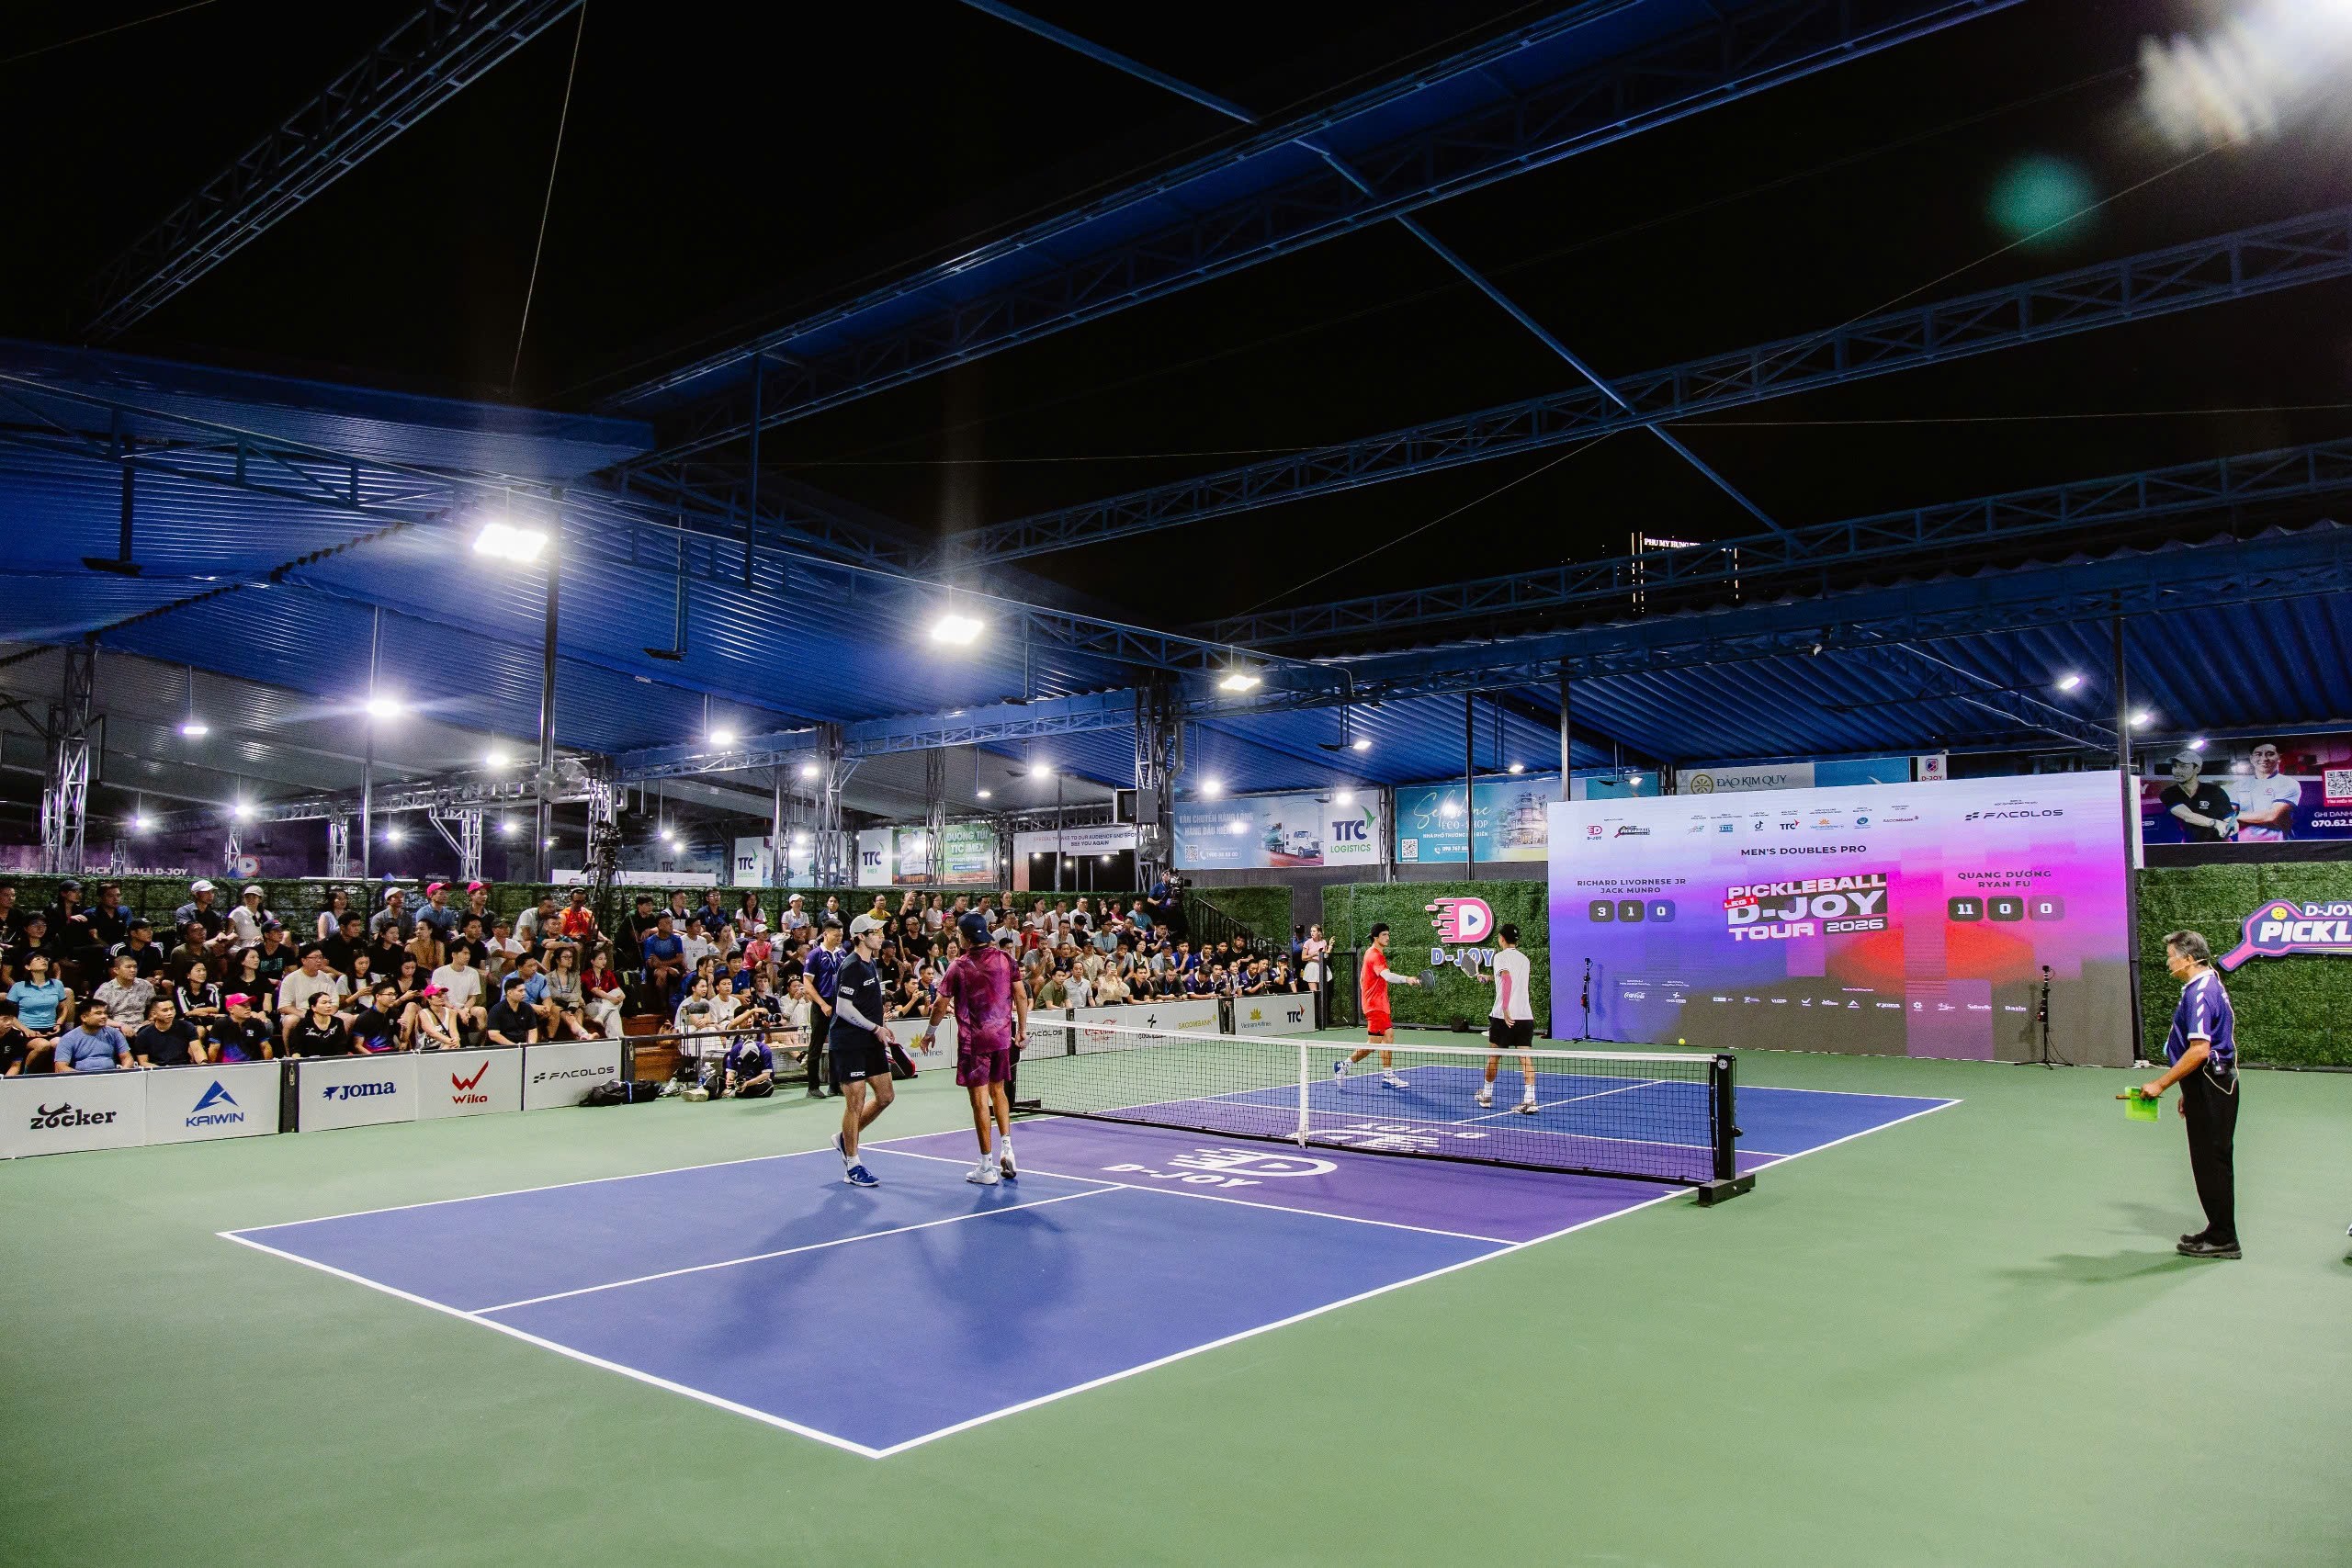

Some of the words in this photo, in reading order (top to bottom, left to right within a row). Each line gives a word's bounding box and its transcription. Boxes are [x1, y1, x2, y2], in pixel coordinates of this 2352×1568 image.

[1742, 776, 1760, 787] KIM
[1762, 774, 1787, 787] QUY
[1983, 809, 2064, 818] FACOLOS
[1332, 819, 1368, 840] TTC
[1330, 843, 1371, 853] LOGISTICS
[1741, 848, 1776, 856] MEN'S
[1780, 845, 1837, 855] DOUBLES
[1840, 845, 1866, 853] PRO
[738, 856, 754, 871] TTC
[862, 851, 882, 866] TTC
[155, 867, 188, 876] D-JOY
[1958, 872, 2001, 880] QUANG
[1728, 874, 1886, 899] PICKLEBALL
[1724, 899, 1747, 908] LEG
[1727, 889, 1885, 926] D-JOY
[1958, 903, 1973, 915] 11
[1999, 903, 2011, 914] 0
[2040, 902, 2052, 914] 0
[1598, 907, 1607, 917] 3
[1627, 906, 1634, 917] 1
[1657, 906, 1666, 917] 0
[1728, 922, 1815, 942] TOUR
[1826, 919, 1883, 933] 2026
[2258, 920, 2352, 942] PICKL
[1430, 947, 1495, 967] D-JOY
[1286, 1010, 1302, 1023] TTC
[1178, 1019, 1212, 1030] SACOMBANK
[548, 1066, 615, 1081] FACOLOS
[30, 1108, 117, 1130] zocker
[186, 1111, 244, 1128] KAIWIN
[1101, 1163, 1263, 1188] D-JOY
